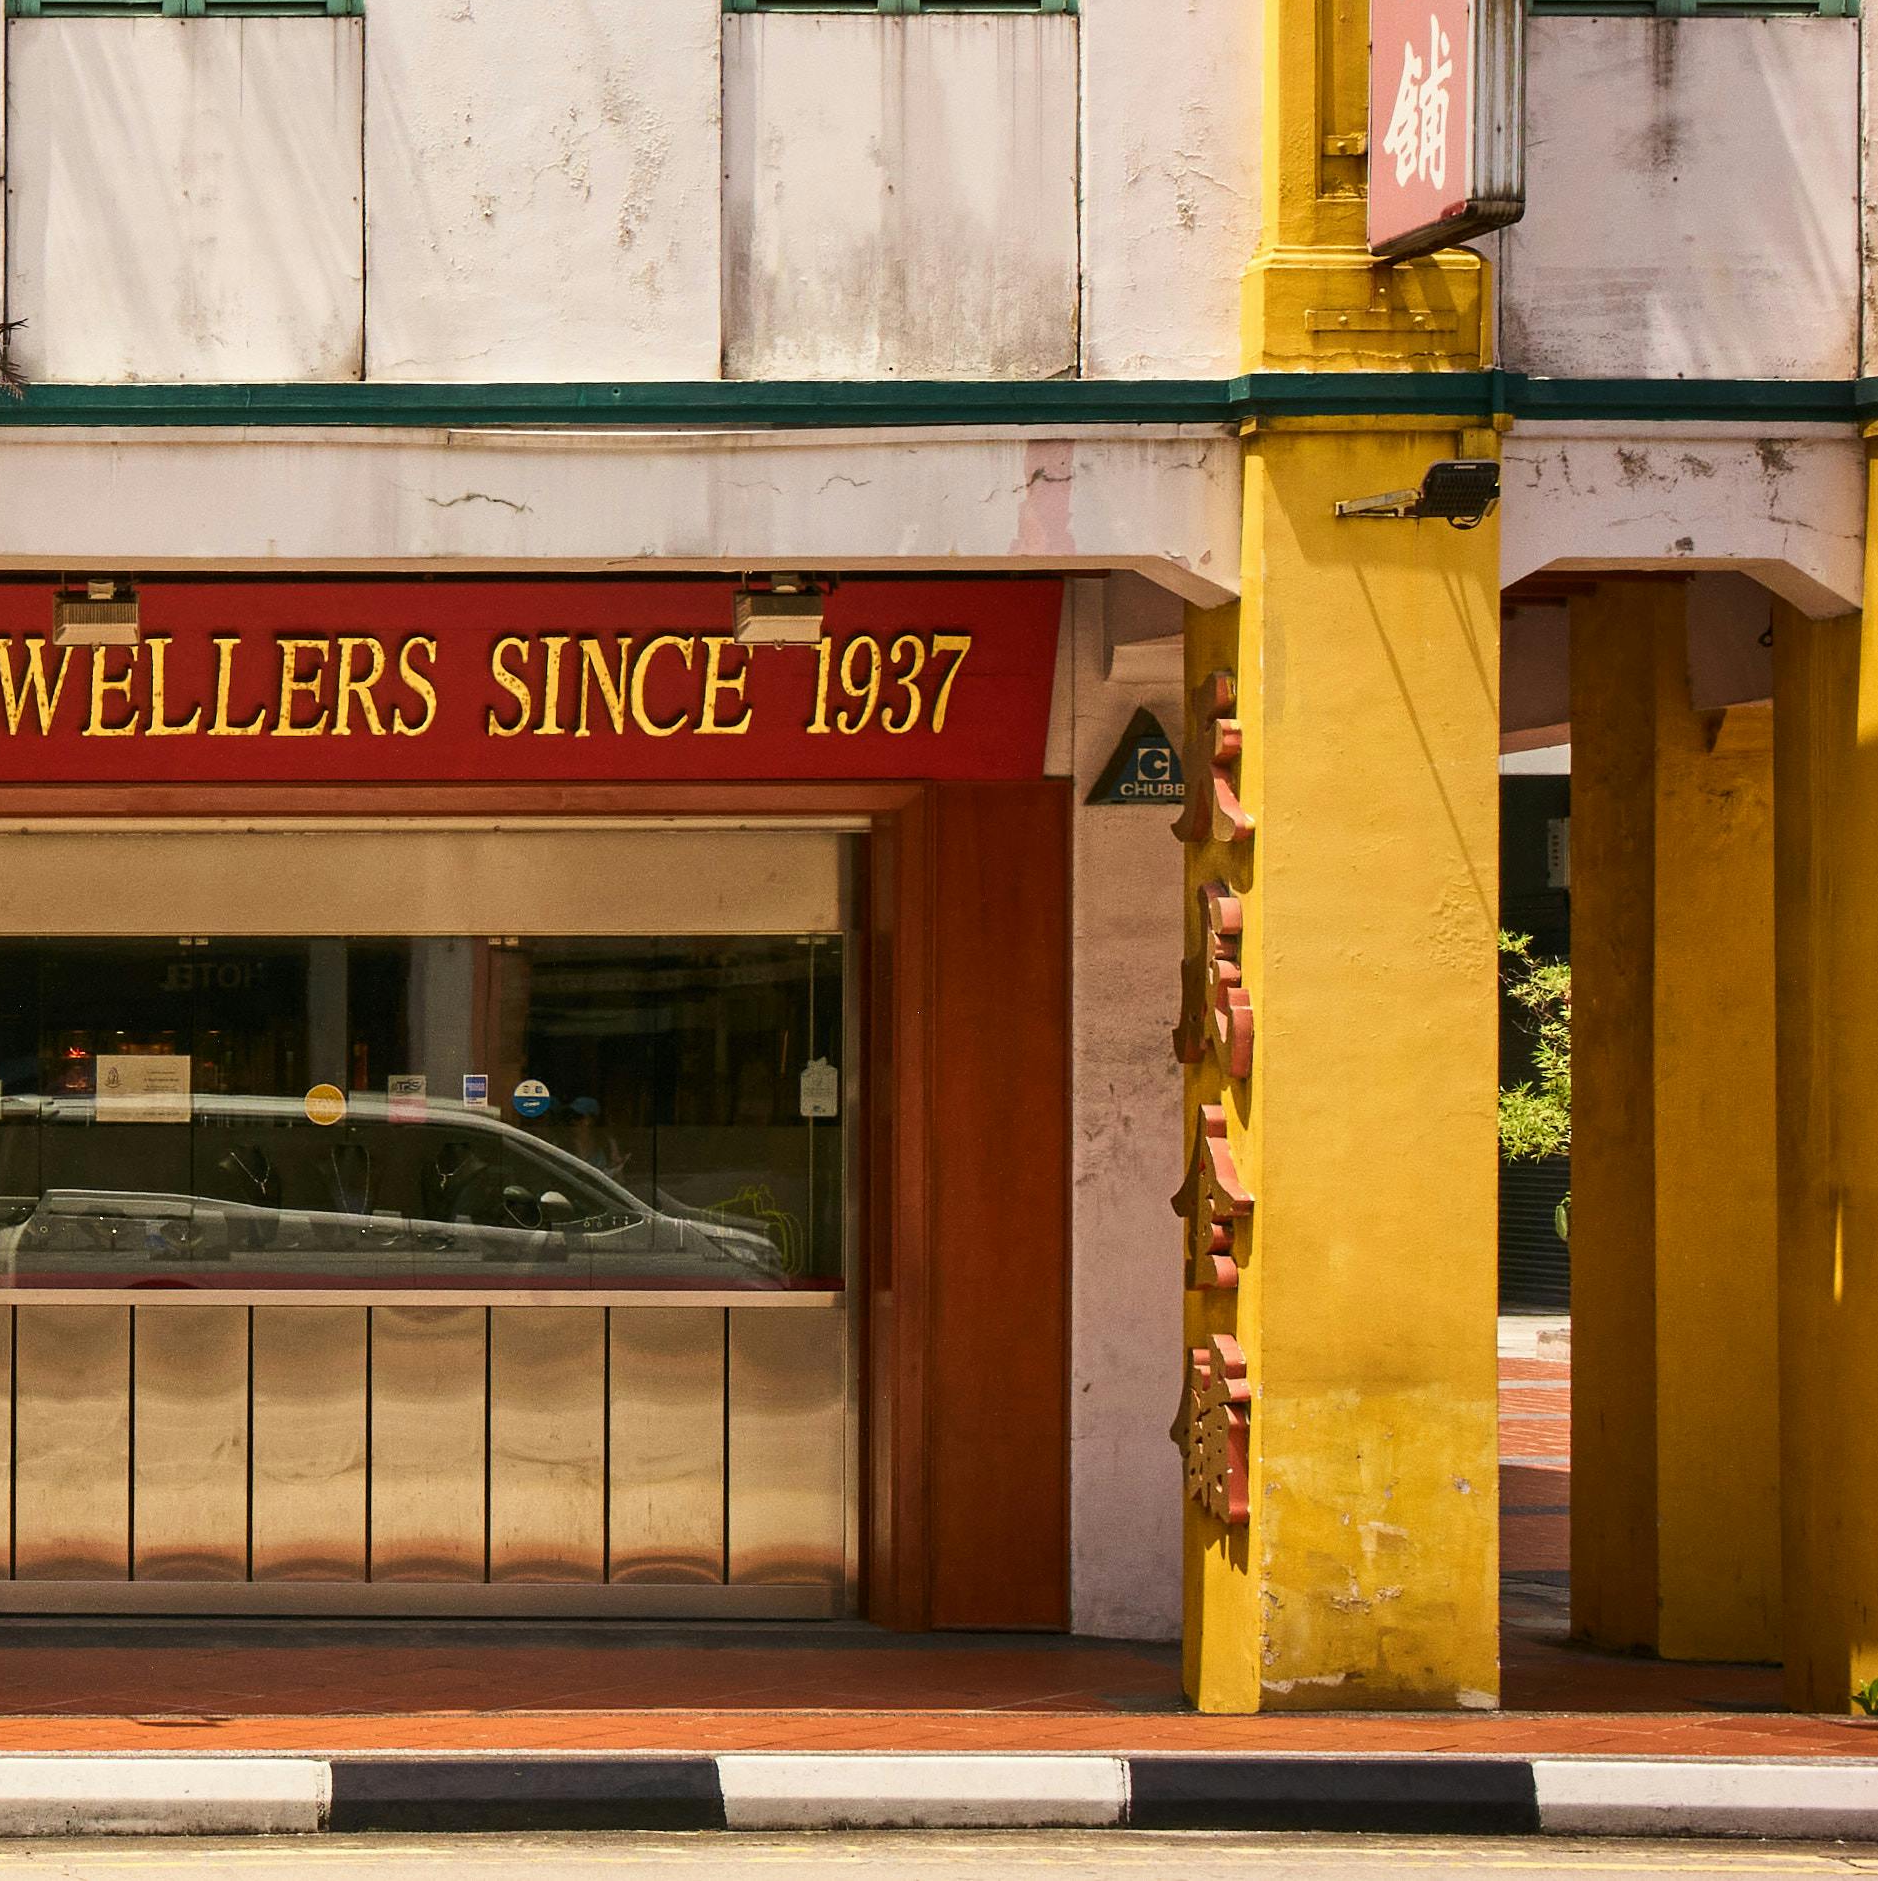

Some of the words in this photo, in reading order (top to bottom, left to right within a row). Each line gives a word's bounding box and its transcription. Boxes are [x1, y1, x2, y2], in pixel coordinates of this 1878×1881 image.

[488, 635, 754, 738] SINCE
[806, 634, 972, 735] 1937
[1120, 782, 1186, 796] CHUBB
